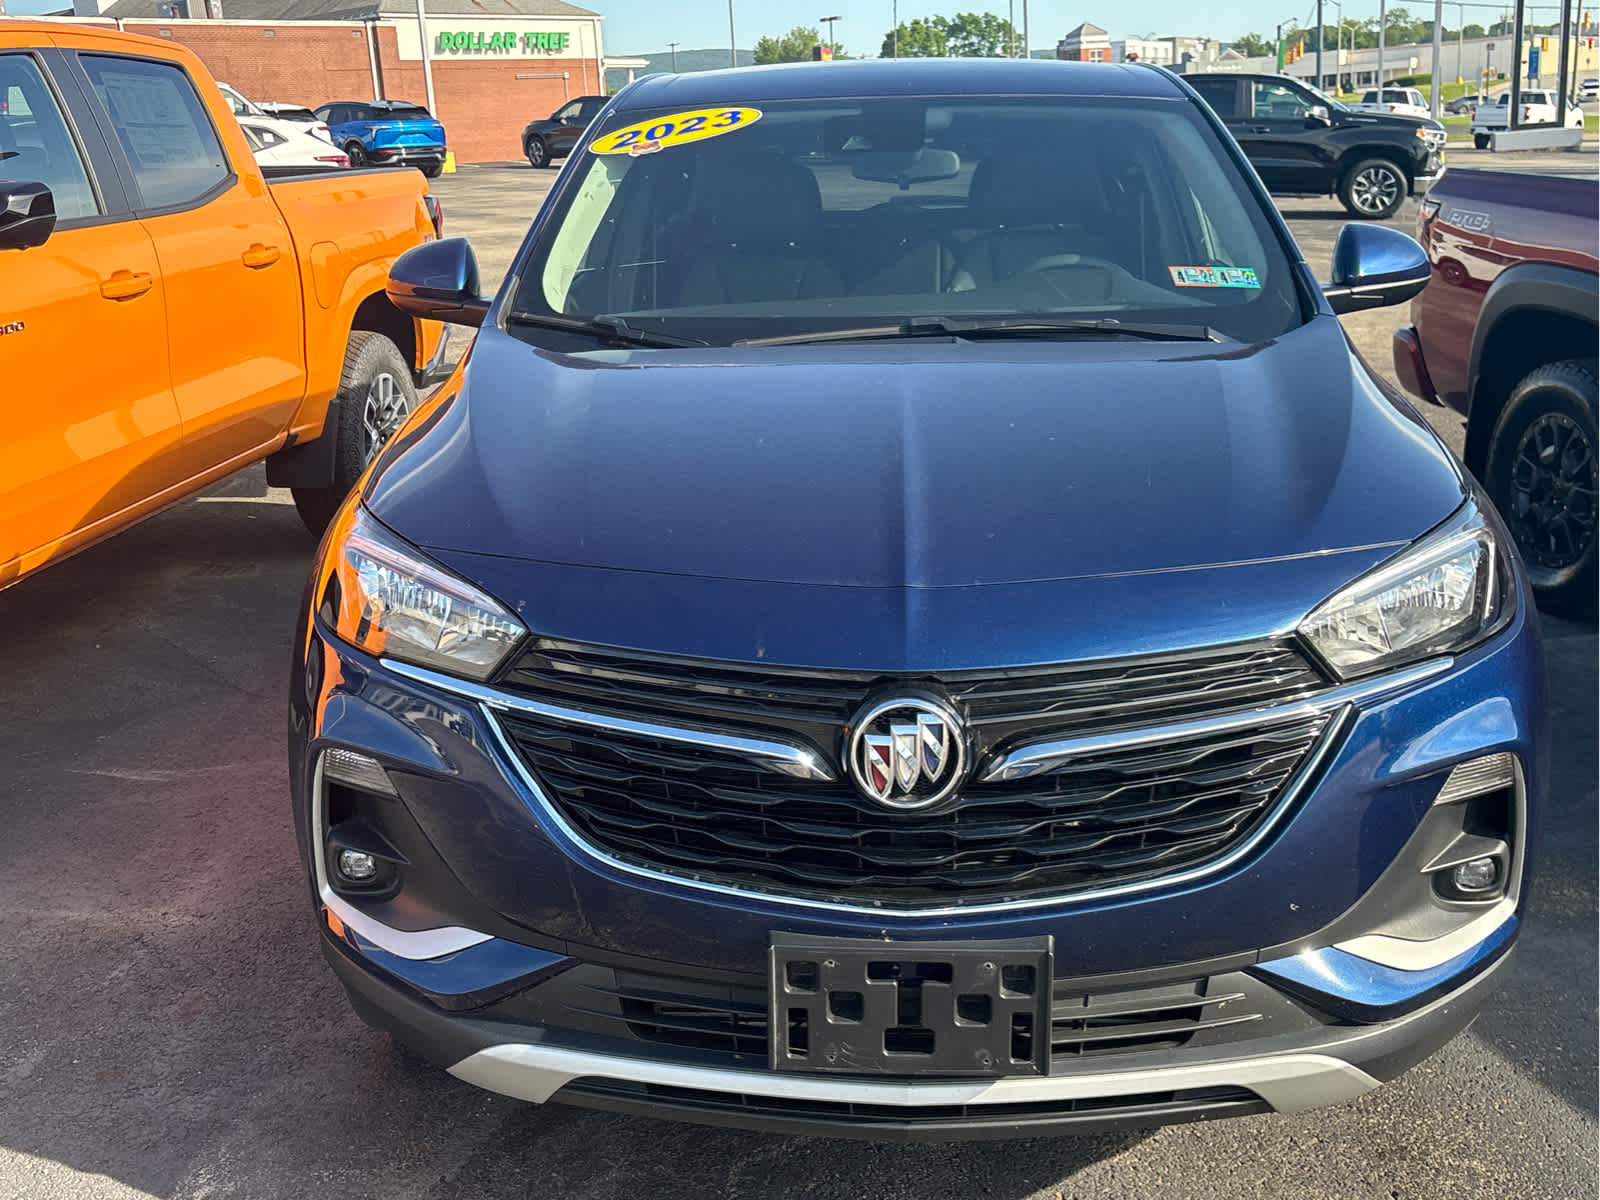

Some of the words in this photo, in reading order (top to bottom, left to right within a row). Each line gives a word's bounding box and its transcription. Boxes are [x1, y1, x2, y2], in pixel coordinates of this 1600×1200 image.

[439, 31, 517, 49] DOLLAR
[524, 31, 570, 49] TREE
[610, 110, 742, 150] 2023
